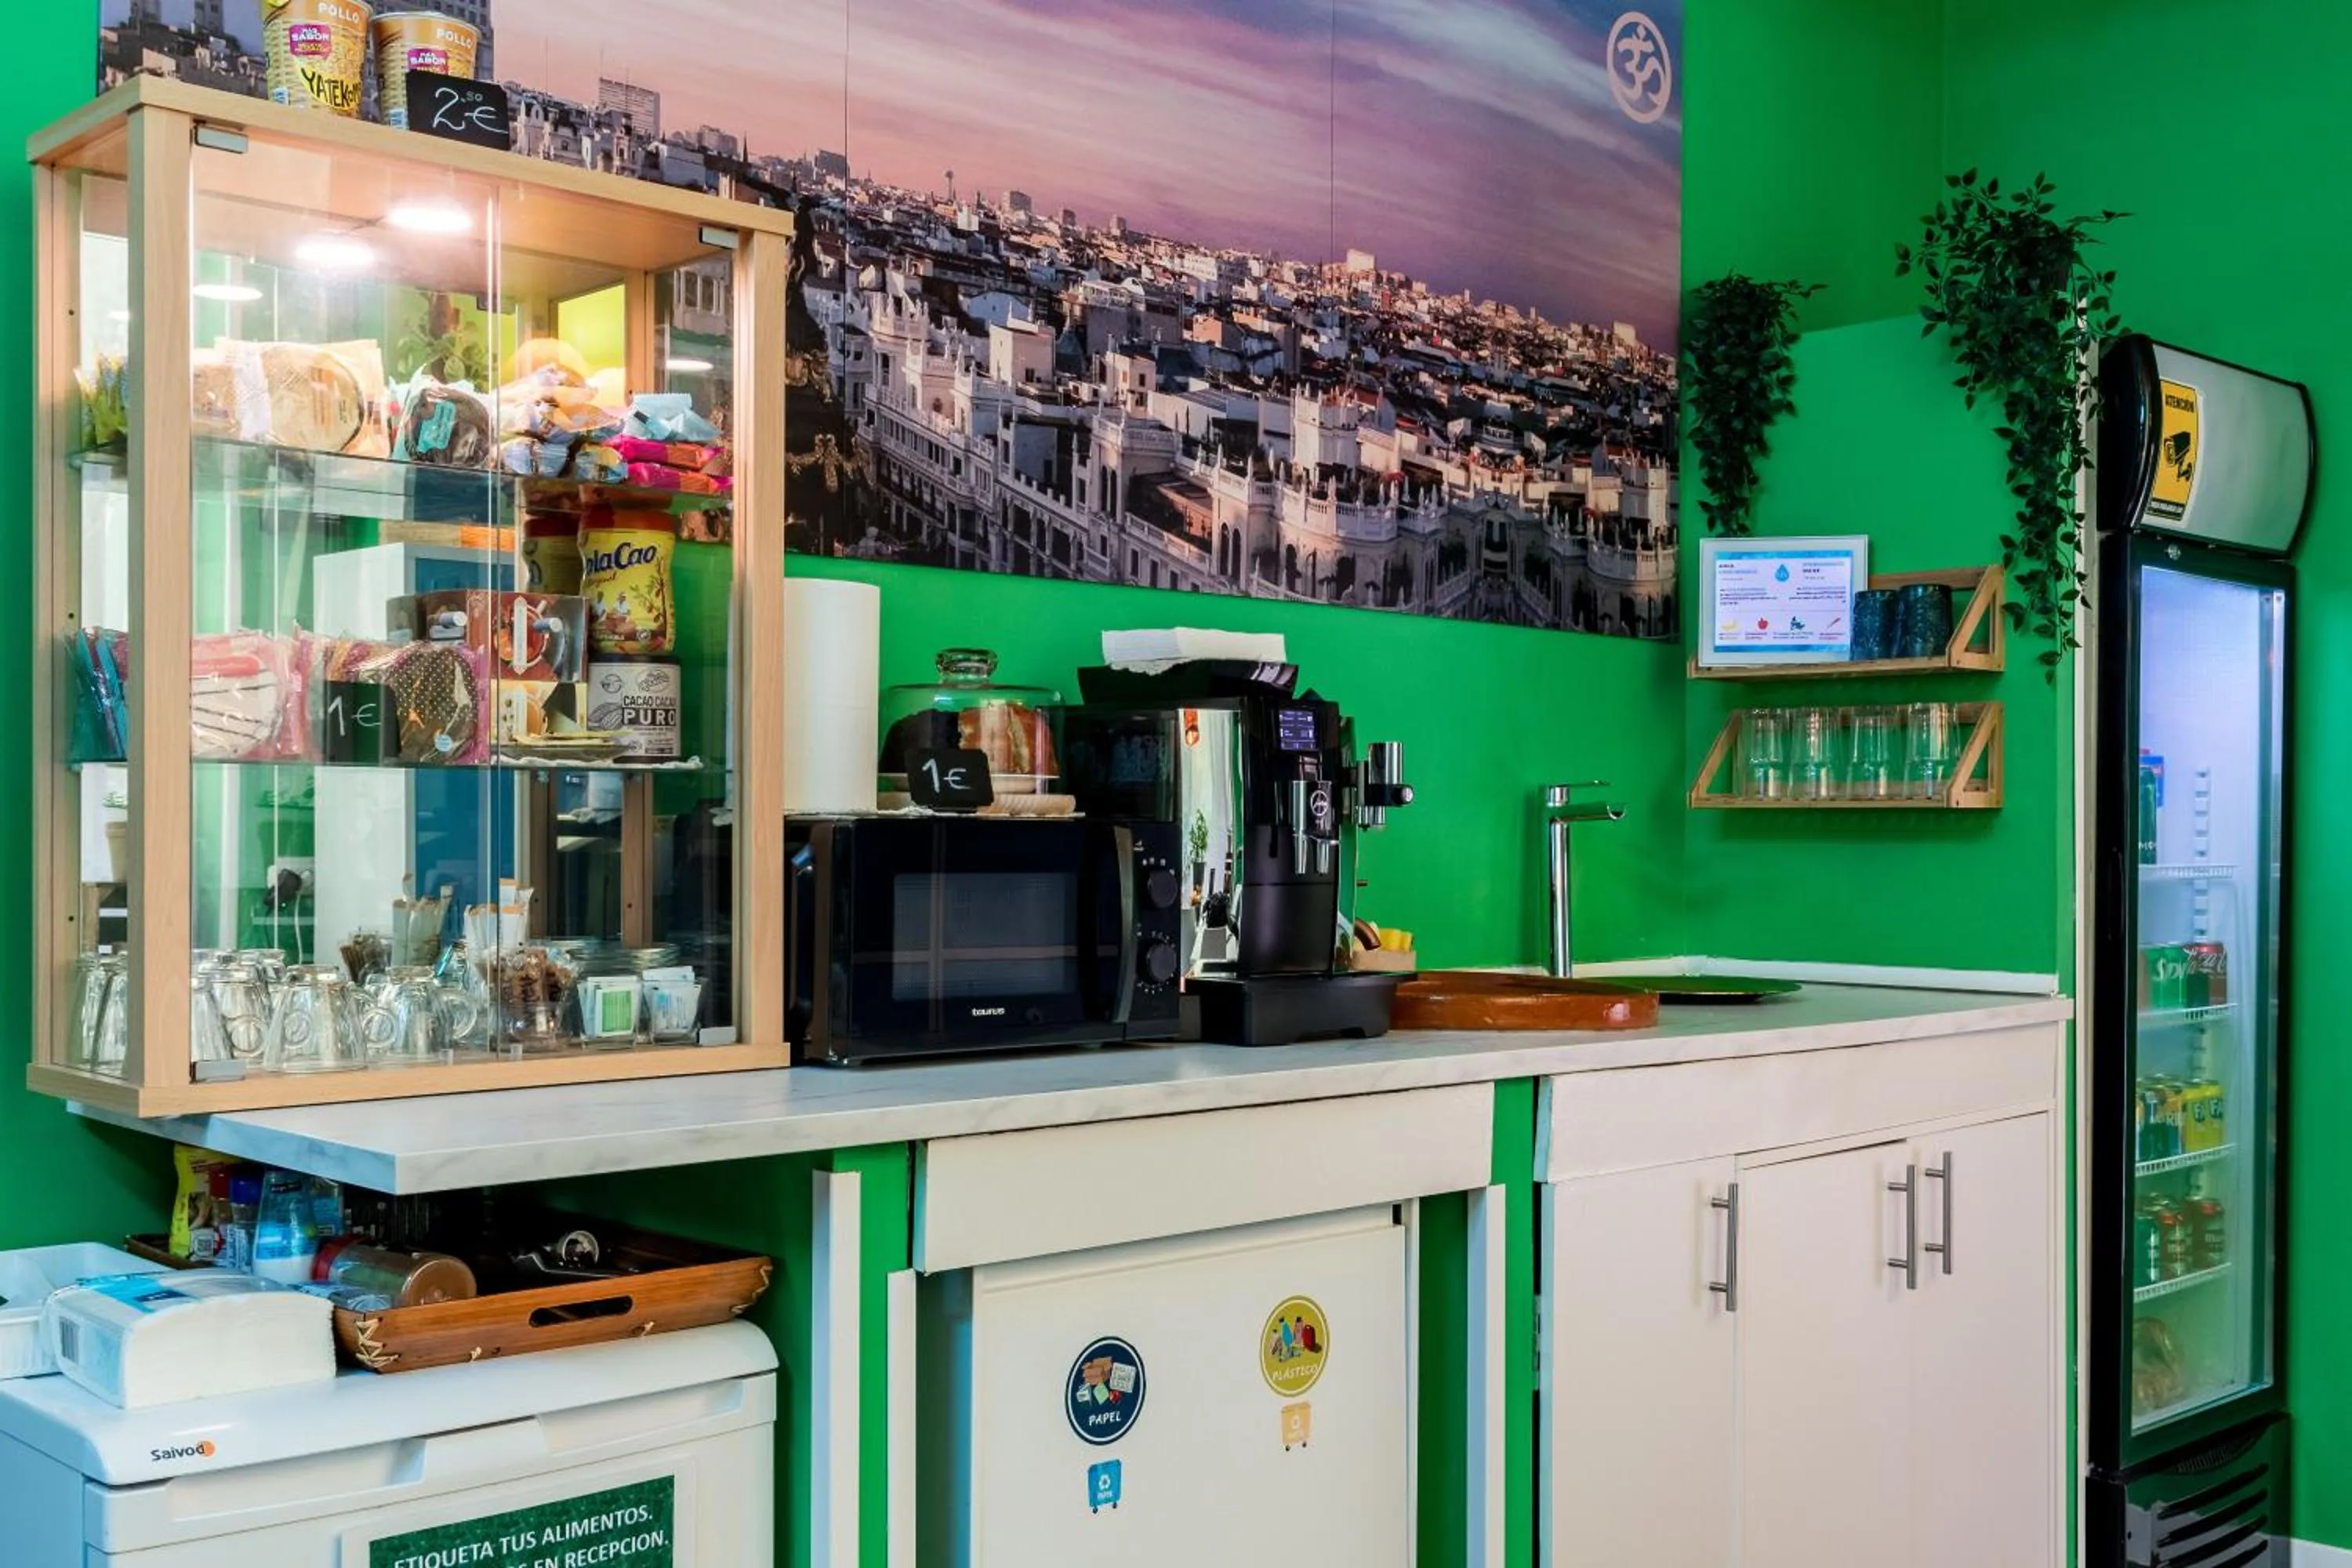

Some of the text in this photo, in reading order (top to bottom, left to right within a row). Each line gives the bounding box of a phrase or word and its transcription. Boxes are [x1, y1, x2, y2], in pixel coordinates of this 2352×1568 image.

[318, 2, 359, 24] POLLO
[291, 33, 329, 42] SABOR
[437, 27, 472, 49] POLLO
[410, 56, 447, 65] SABOR
[623, 695, 653, 706] CACAO
[623, 708, 676, 726] PURO
[971, 1007, 1005, 1016] taurus
[1088, 1411, 1121, 1426] PAPEL
[151, 1443, 205, 1461] Saivod
[499, 1531, 537, 1555] TUS
[542, 1505, 653, 1546] ALIMENTOS.
[564, 1530, 669, 1568] RECEPCION.
